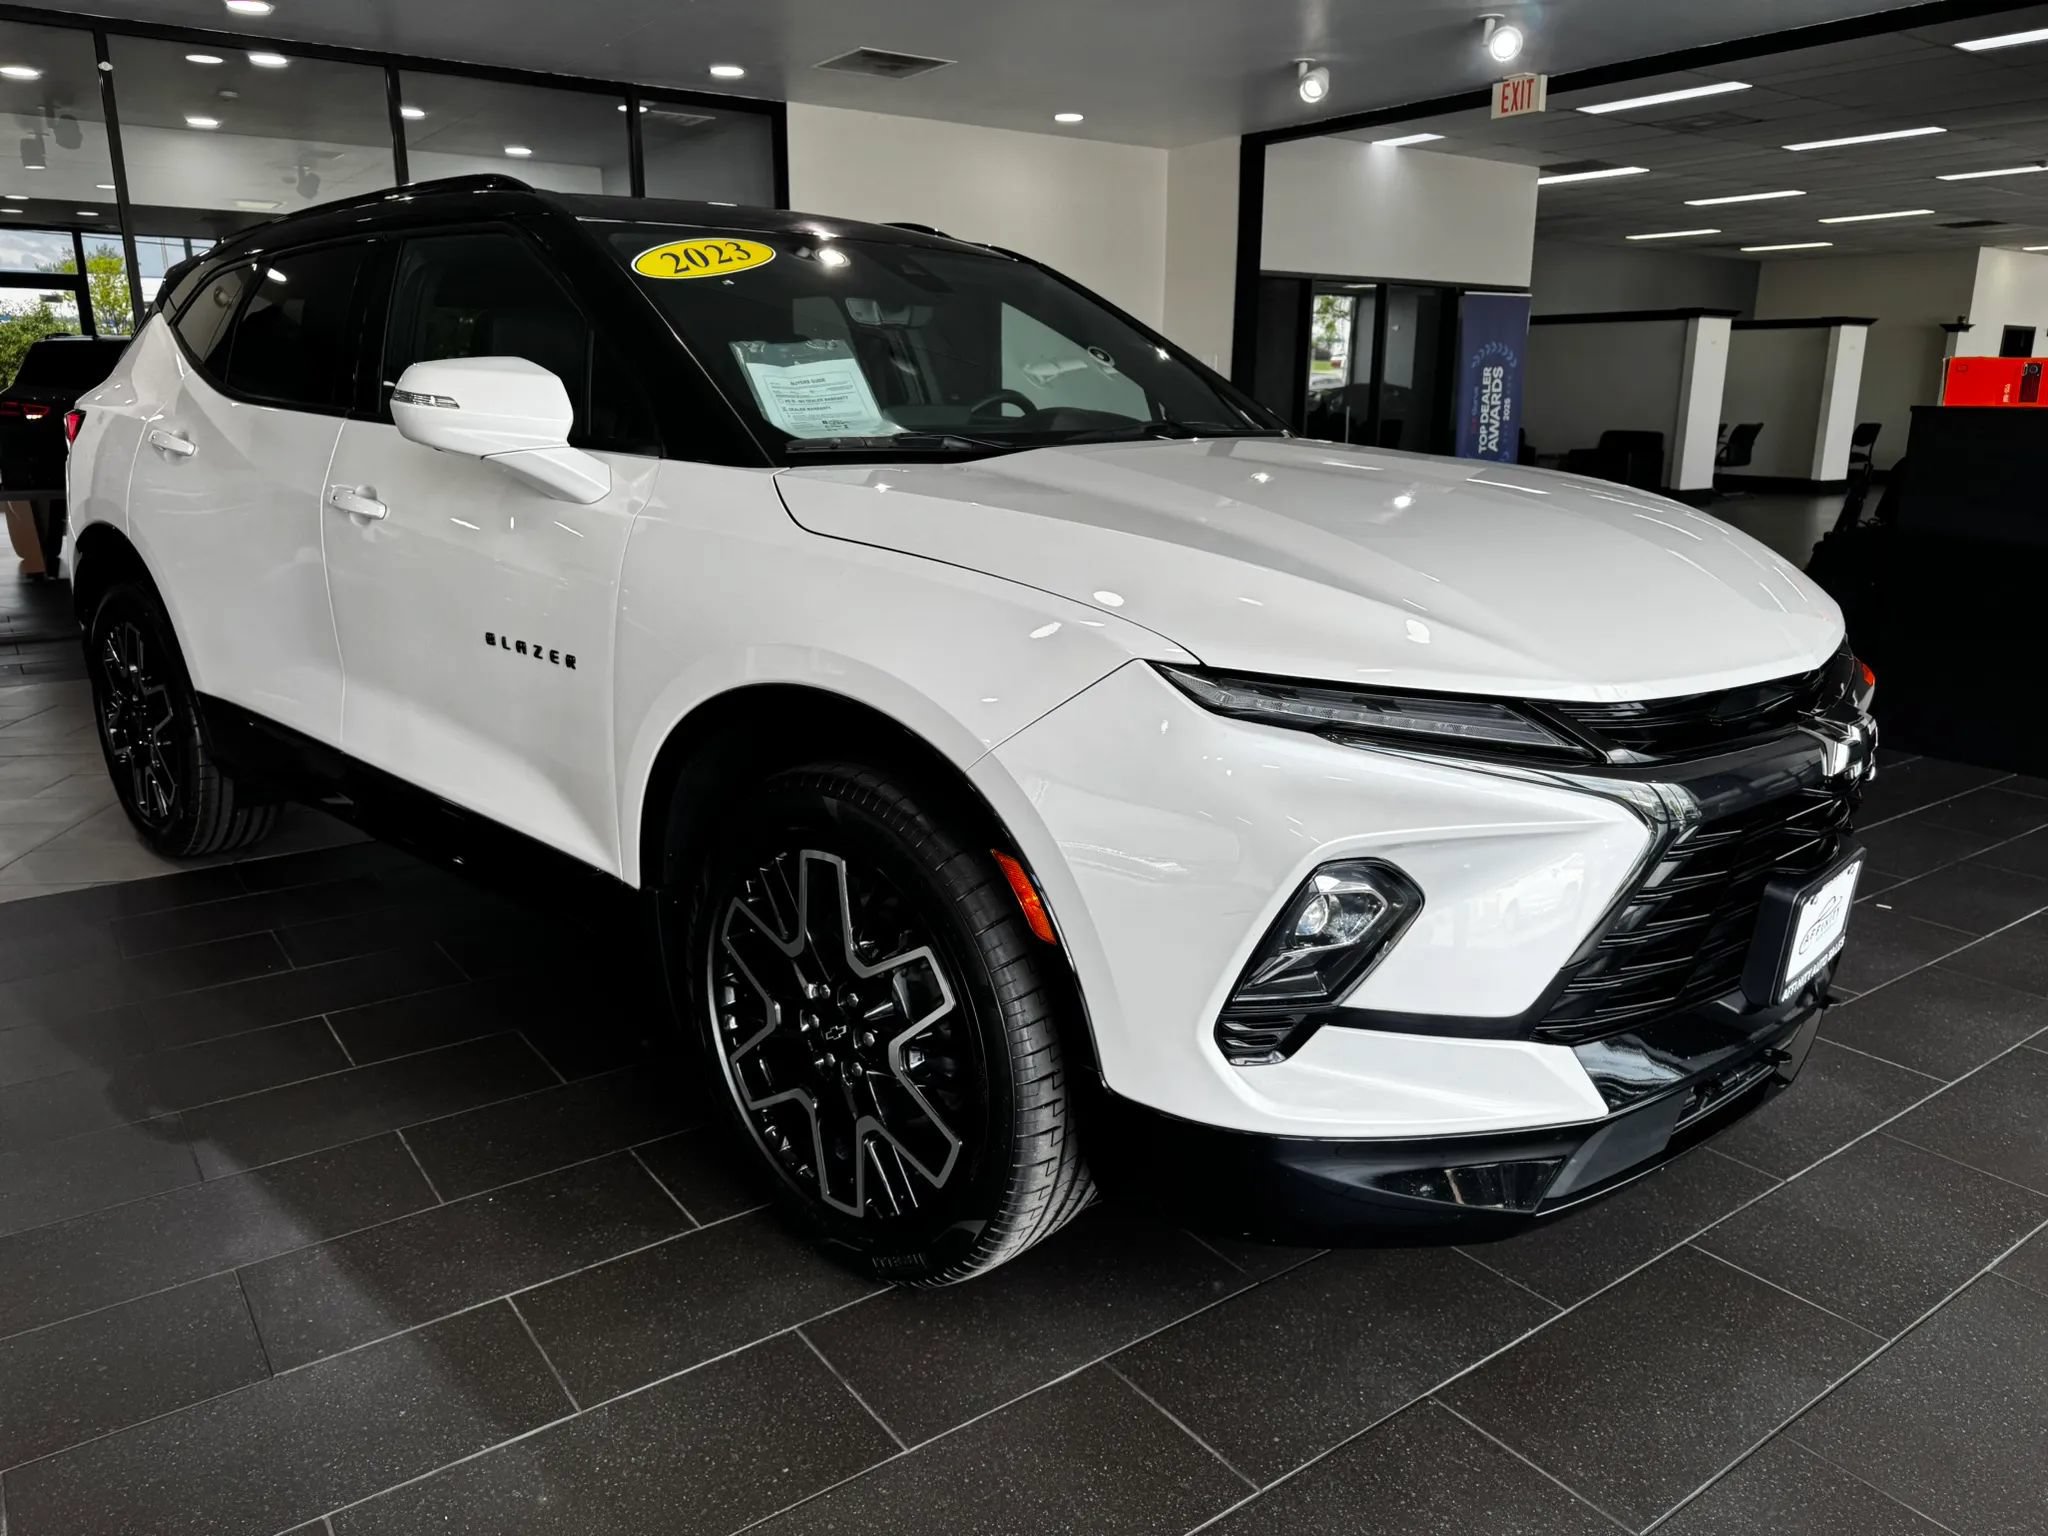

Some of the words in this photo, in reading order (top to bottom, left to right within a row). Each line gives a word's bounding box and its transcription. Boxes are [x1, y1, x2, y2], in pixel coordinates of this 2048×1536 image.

[1501, 79, 1535, 113] EXIT
[660, 242, 751, 274] 2023
[1480, 366, 1492, 424] DEALER
[1487, 366, 1504, 452] AWARDS
[1478, 425, 1488, 453] TOP
[485, 632, 576, 670] BLAZER
